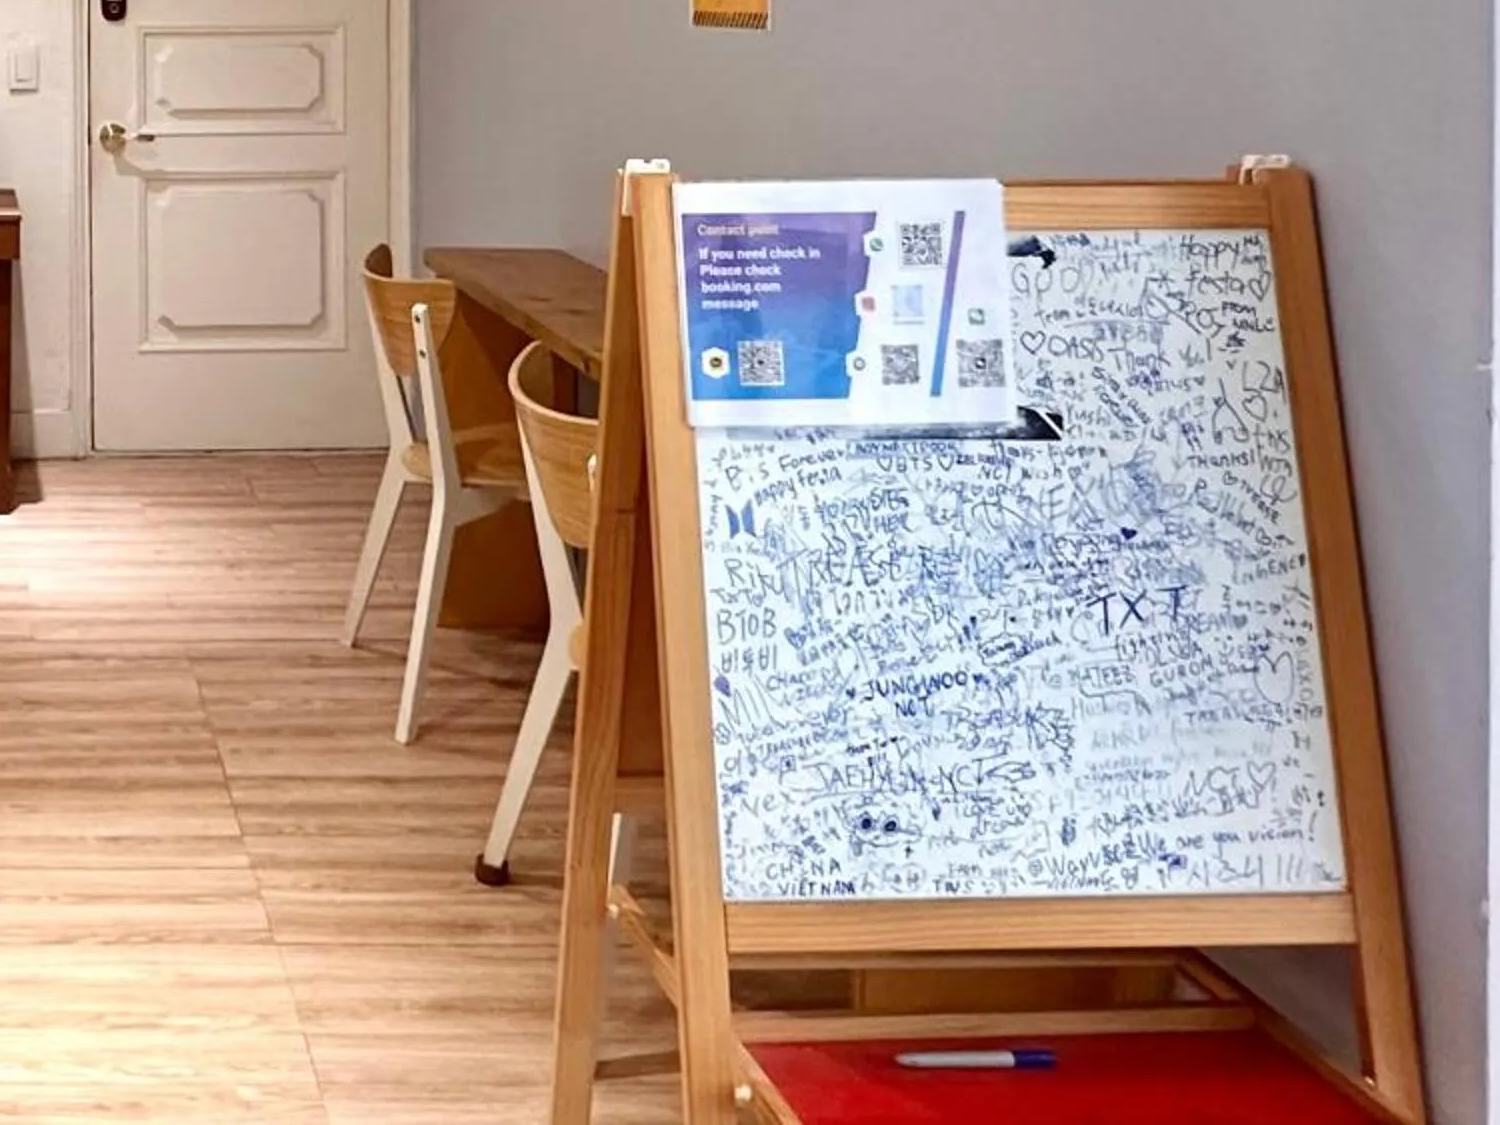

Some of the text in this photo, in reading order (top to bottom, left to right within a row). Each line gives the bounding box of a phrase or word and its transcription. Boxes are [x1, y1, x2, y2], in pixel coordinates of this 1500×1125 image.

[697, 224, 745, 236] Contact
[699, 246, 821, 263] If you need check in
[699, 264, 782, 276] Please check
[701, 281, 781, 294] booking.com
[701, 300, 759, 311] message
[1085, 585, 1188, 637] TXT
